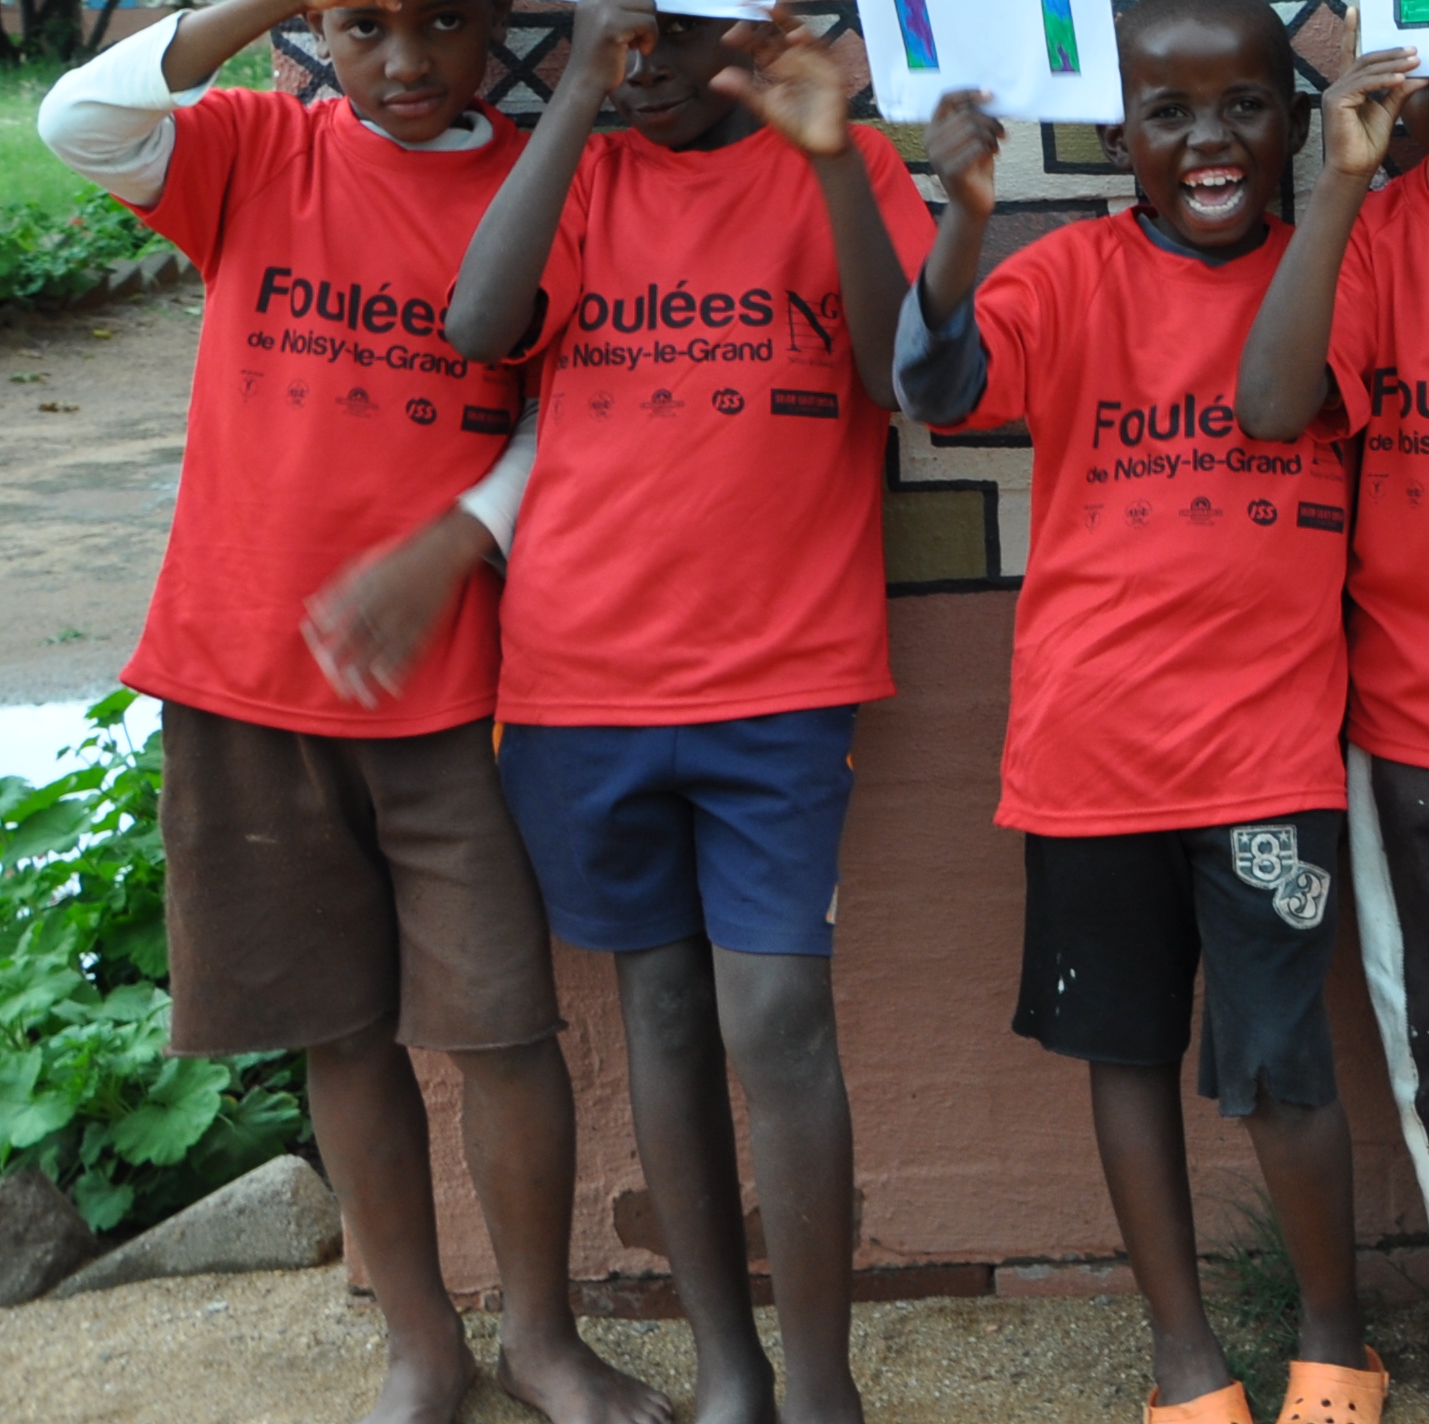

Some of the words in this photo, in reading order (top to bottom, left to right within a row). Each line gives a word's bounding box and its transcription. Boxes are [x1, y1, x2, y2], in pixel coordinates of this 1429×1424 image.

[255, 266, 449, 344] Foulée
[576, 280, 774, 333] oulées
[248, 330, 275, 350] de
[281, 329, 468, 379] Noisy-le-Grand
[573, 338, 774, 371] Noisy-le-Grand
[1369, 433, 1393, 451] de
[1086, 466, 1108, 484] de
[1114, 448, 1303, 481] Noisy-le-Grand
[1251, 833, 1281, 881] 8
[1289, 872, 1321, 919] 3
